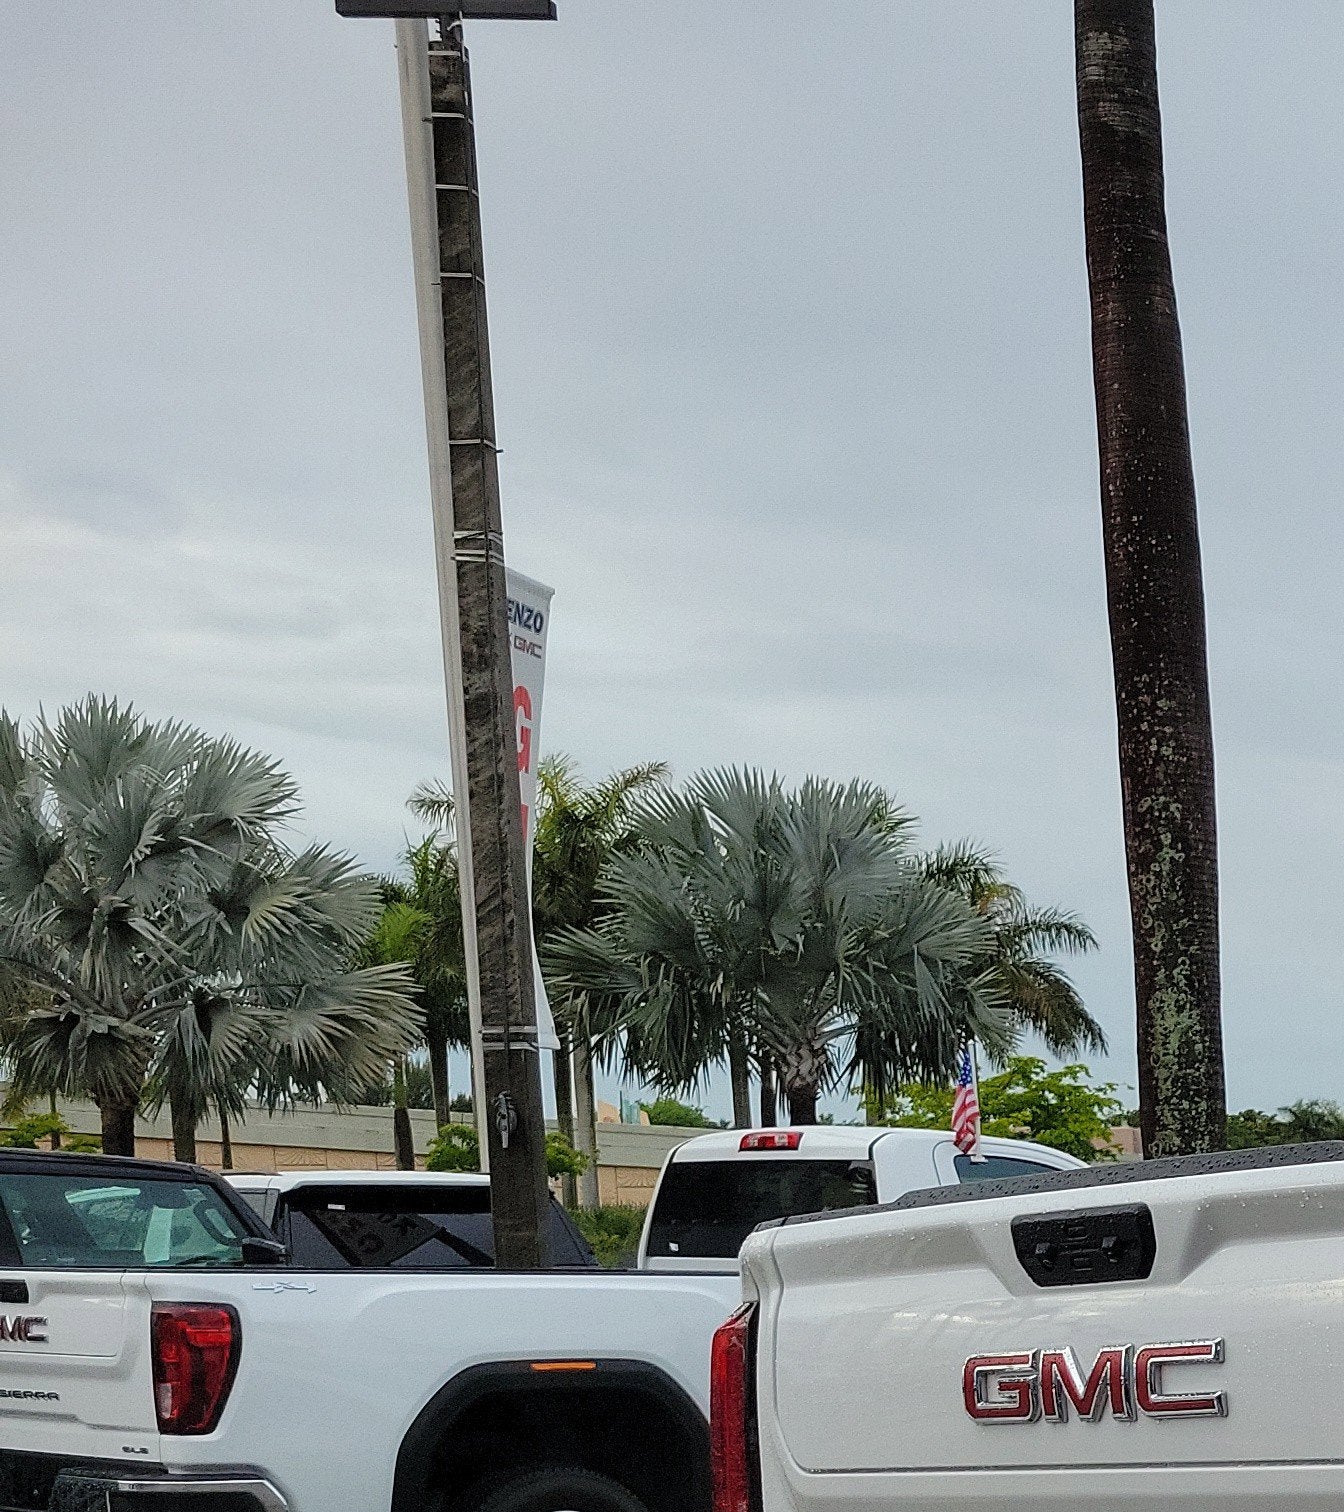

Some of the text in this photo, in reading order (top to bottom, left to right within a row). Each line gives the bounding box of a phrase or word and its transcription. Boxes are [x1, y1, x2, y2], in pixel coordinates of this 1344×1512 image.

[506, 599, 544, 635] ENZO
[514, 635, 542, 659] GMC
[0, 1314, 48, 1343] MC
[962, 1336, 1229, 1426] GMC
